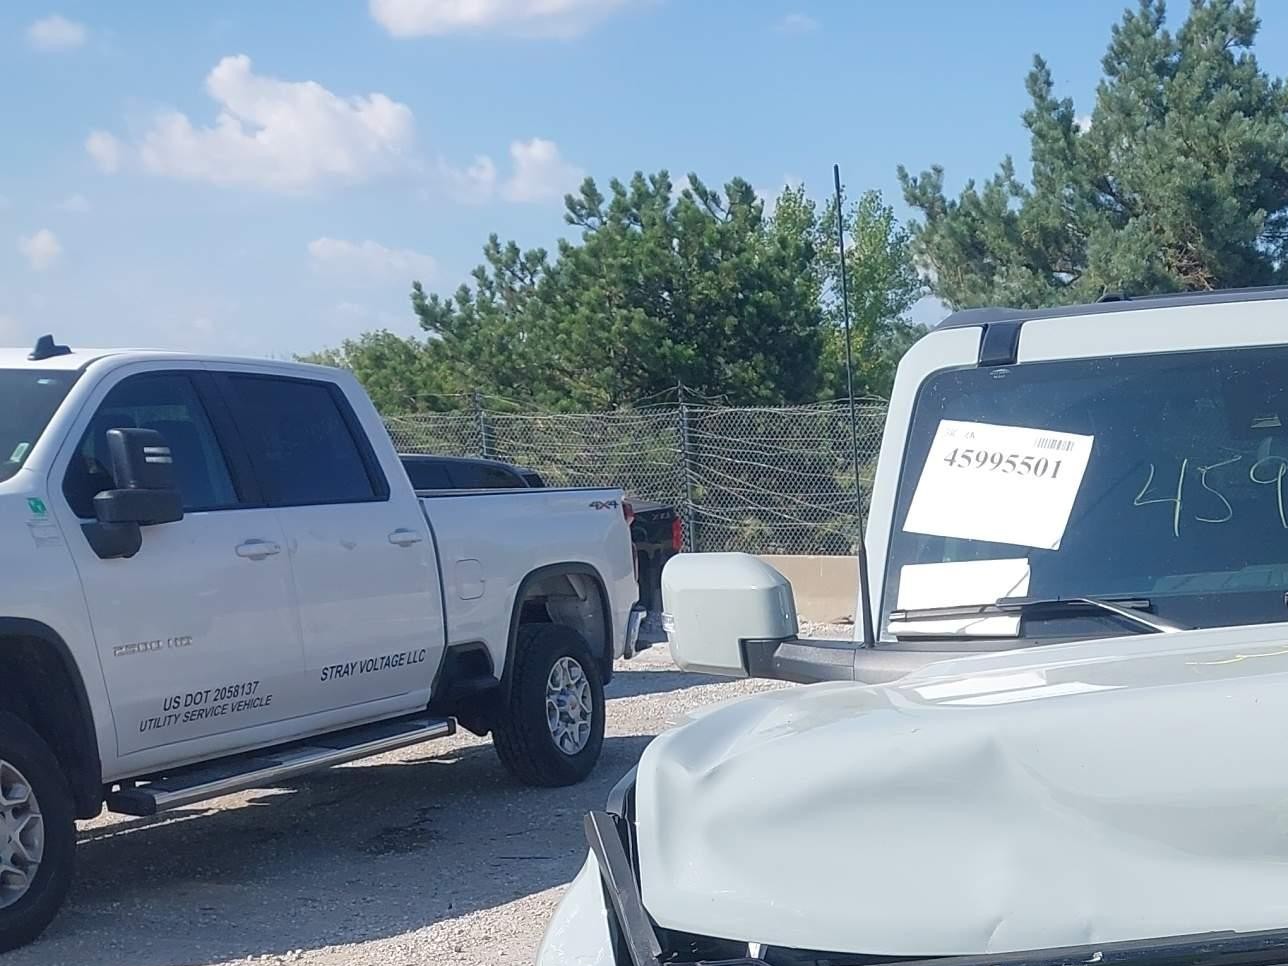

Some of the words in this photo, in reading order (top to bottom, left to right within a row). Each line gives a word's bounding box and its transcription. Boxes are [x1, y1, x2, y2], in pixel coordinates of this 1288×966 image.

[943, 447, 1063, 479] 45995501
[320, 661, 357, 681] STRAY
[359, 652, 406, 673] VOLTAGE
[406, 649, 426, 665] LLC
[163, 695, 181, 711] US
[184, 689, 211, 707] DOT
[213, 680, 260, 702] 2058137
[139, 713, 181, 732] UTILITY
[182, 703, 228, 723] SERVICE
[230, 694, 273, 713] VEHICLE
